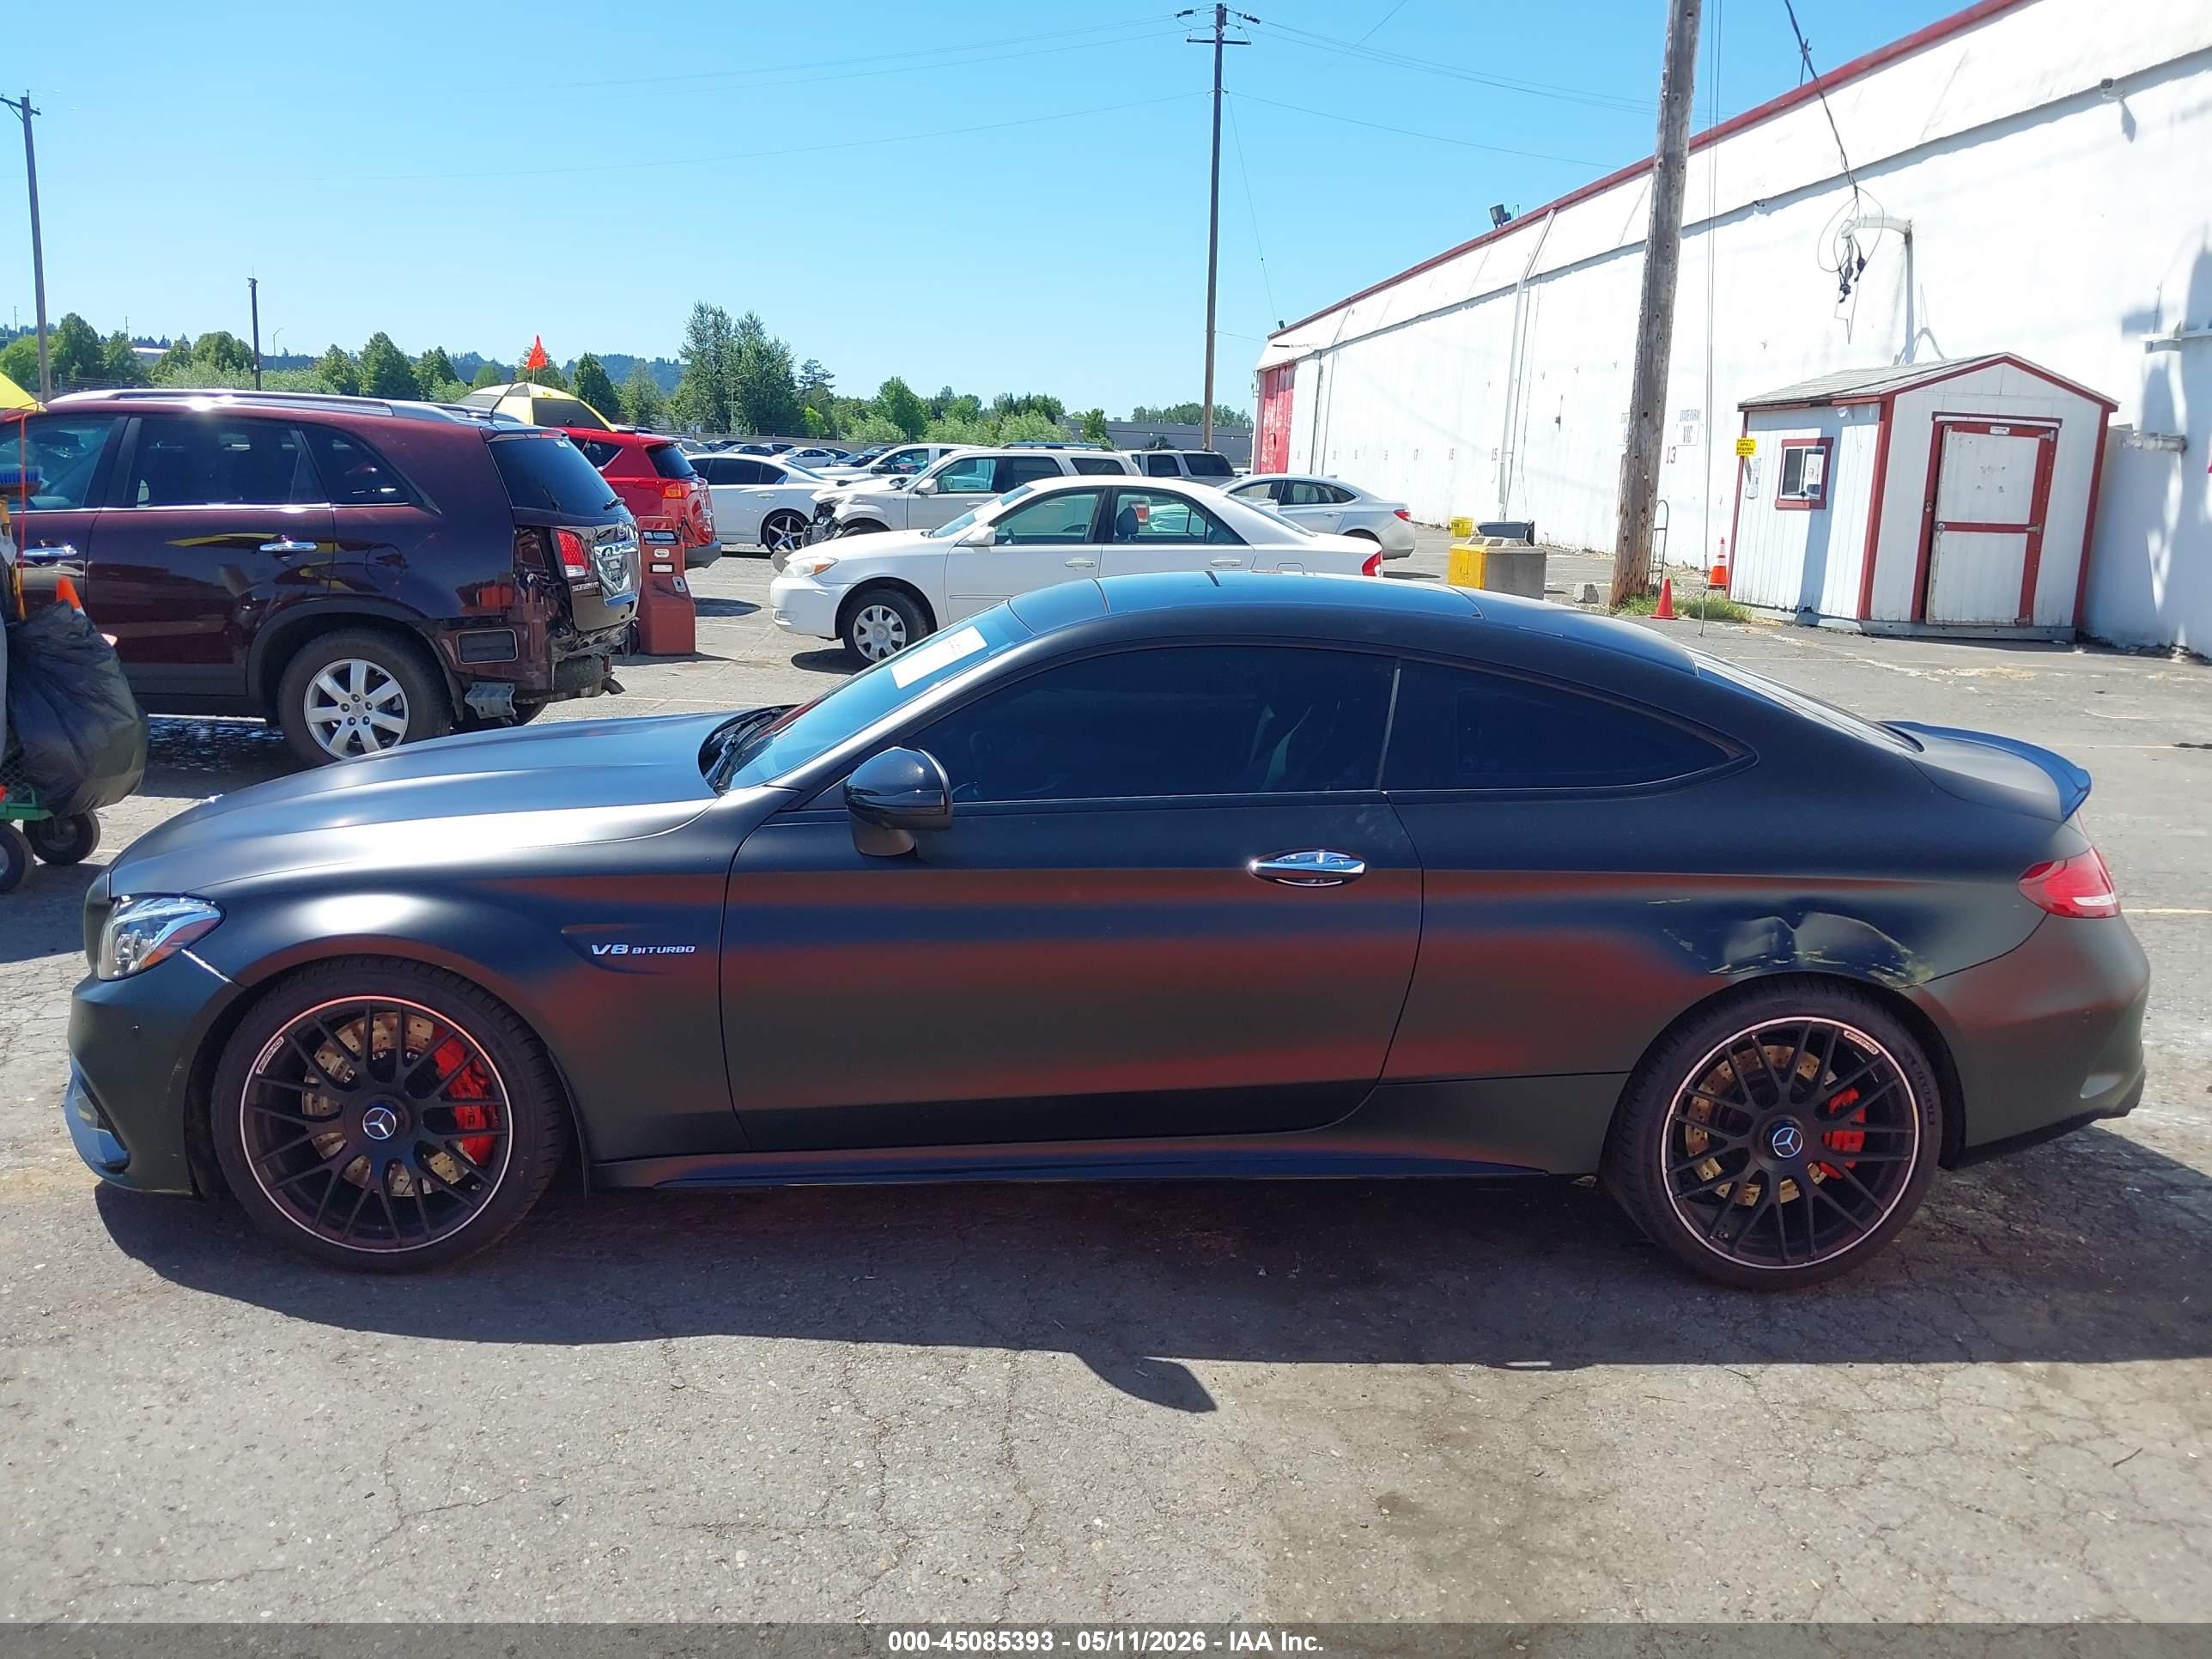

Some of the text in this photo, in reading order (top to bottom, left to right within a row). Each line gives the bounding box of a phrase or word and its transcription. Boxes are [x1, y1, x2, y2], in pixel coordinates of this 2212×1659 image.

[1666, 446, 1677, 465] 13
[590, 943, 696, 955] V8 BITURBO
